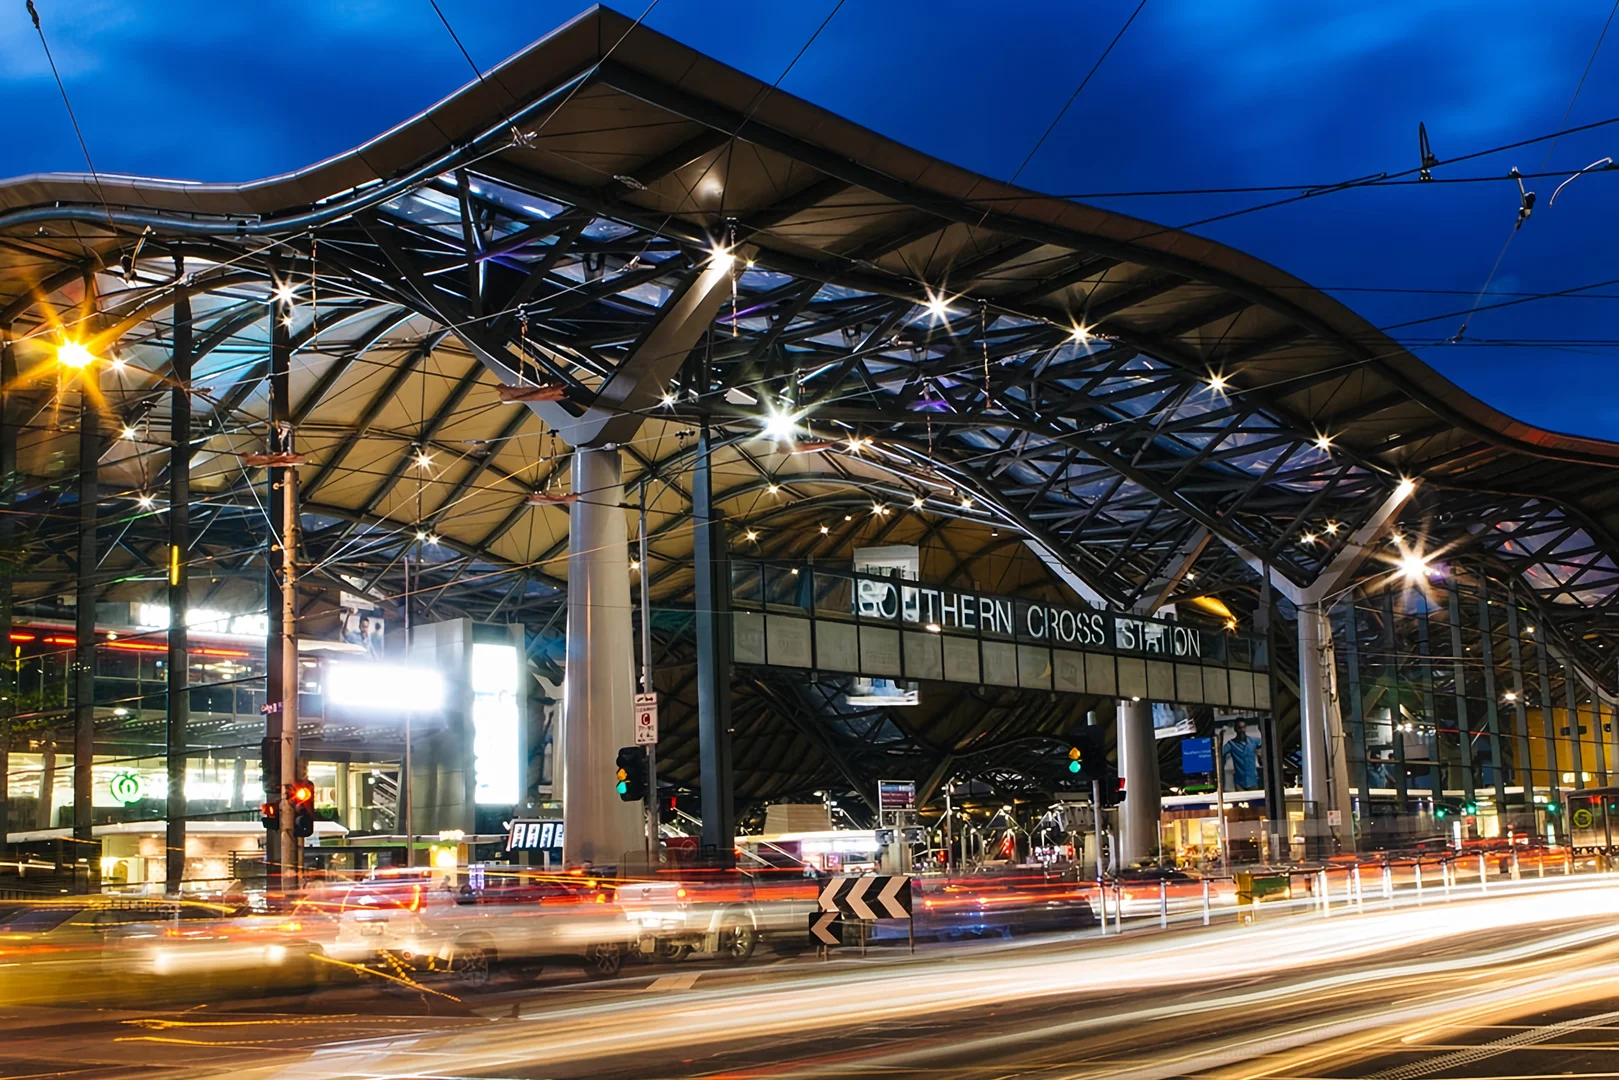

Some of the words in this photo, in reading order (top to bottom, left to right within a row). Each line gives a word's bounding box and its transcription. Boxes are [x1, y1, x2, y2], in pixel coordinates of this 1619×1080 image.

[858, 579, 1013, 635] SOUTHERN
[1027, 604, 1105, 646] CROSS
[1121, 618, 1201, 658] STATION
